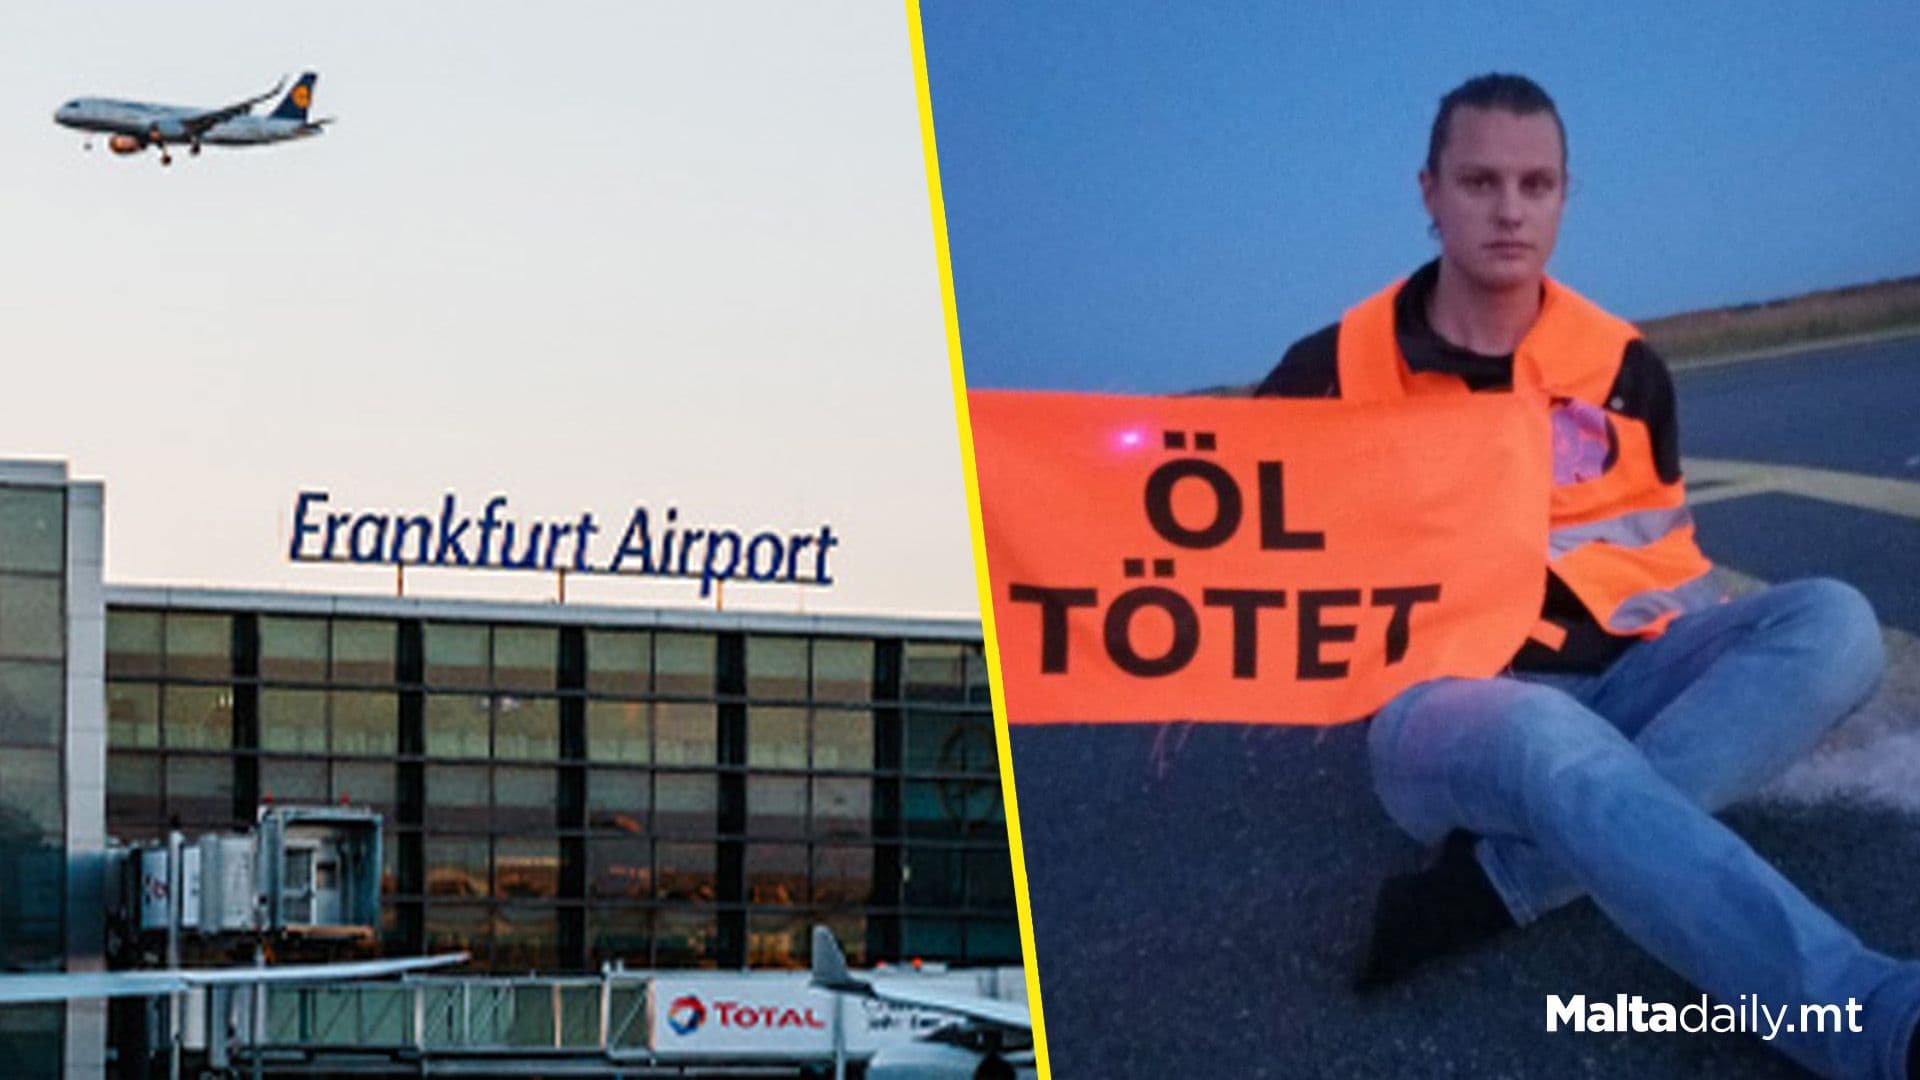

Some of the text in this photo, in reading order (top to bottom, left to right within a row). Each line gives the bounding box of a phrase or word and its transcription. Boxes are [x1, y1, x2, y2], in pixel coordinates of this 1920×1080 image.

[289, 491, 838, 598] Frankfurt Airport
[1144, 430, 1326, 550] ÖL
[1008, 557, 1442, 680] TÖTET
[712, 1001, 825, 1029] TOTAL
